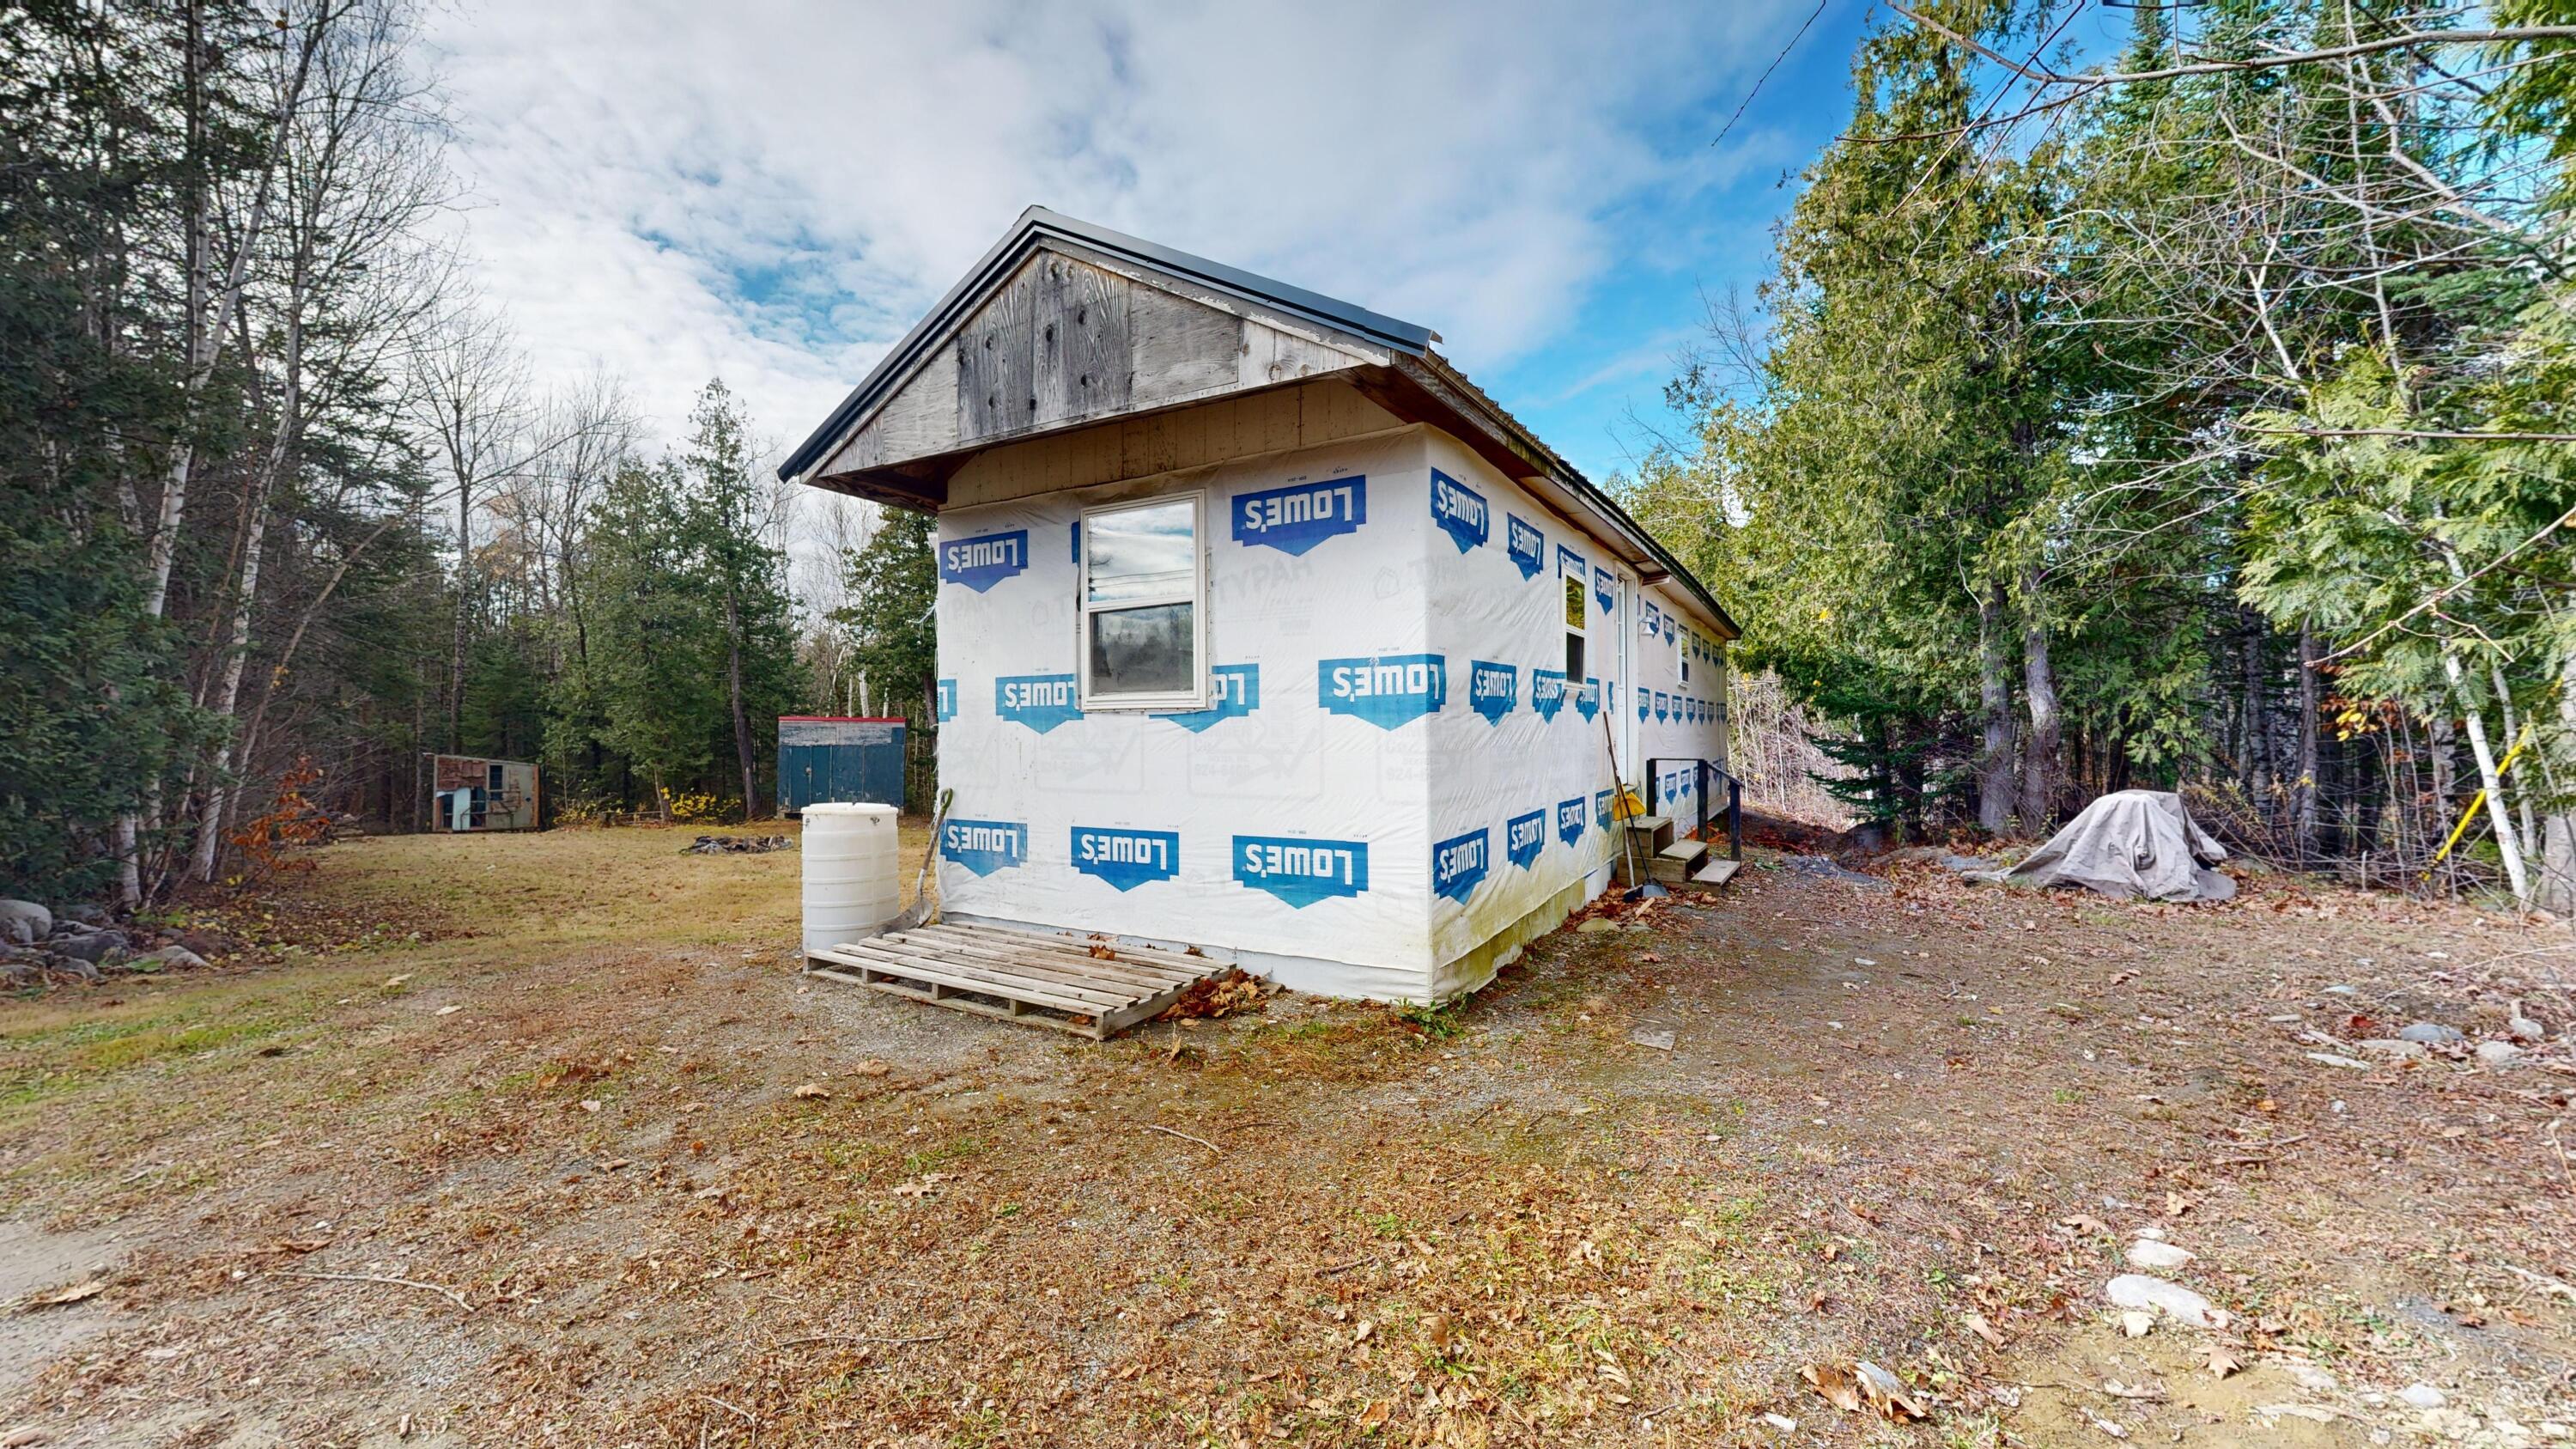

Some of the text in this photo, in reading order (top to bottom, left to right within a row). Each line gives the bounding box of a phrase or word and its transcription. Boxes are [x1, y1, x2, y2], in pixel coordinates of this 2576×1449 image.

[1245, 487, 1352, 533] LOWE'S
[1438, 479, 1484, 535] LOWE'S
[948, 539, 1018, 573] LOWE'S
[1512, 521, 1540, 565] LOWE'S
[1333, 664, 1439, 702] LOWE'S
[1475, 669, 1513, 702] LOWE'S
[948, 825, 1018, 856] LOWE'S
[1081, 834, 1167, 871] LOWE'S
[1511, 817, 1543, 853] LOWE'S
[1245, 843, 1352, 886] LOWE'S
[1440, 837, 1484, 883] LOWE'S
